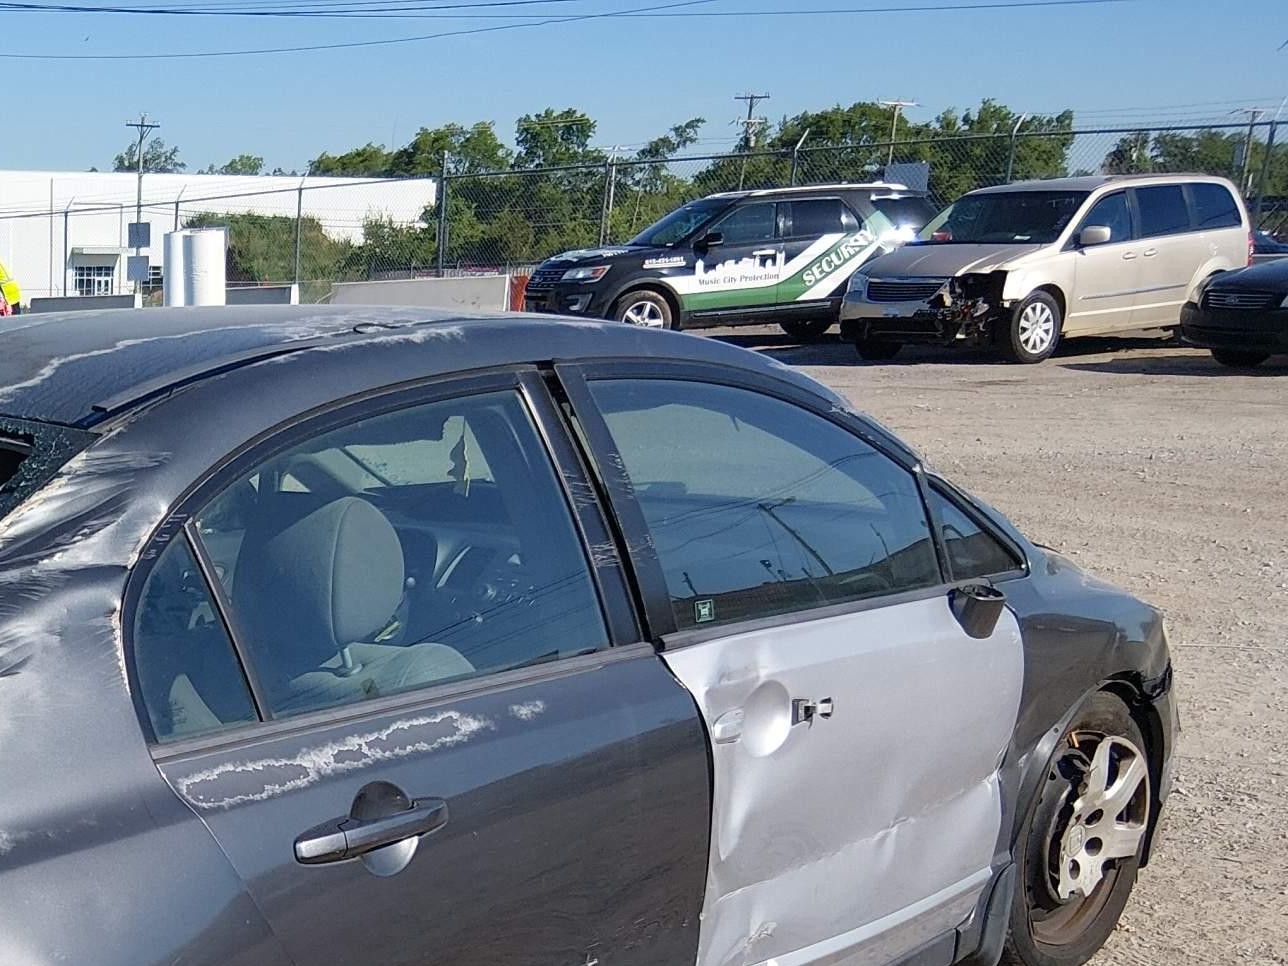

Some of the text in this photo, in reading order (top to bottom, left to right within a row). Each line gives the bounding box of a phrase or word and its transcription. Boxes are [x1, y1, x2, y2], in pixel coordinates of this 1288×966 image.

[698, 272, 780, 286] Music City Protection
